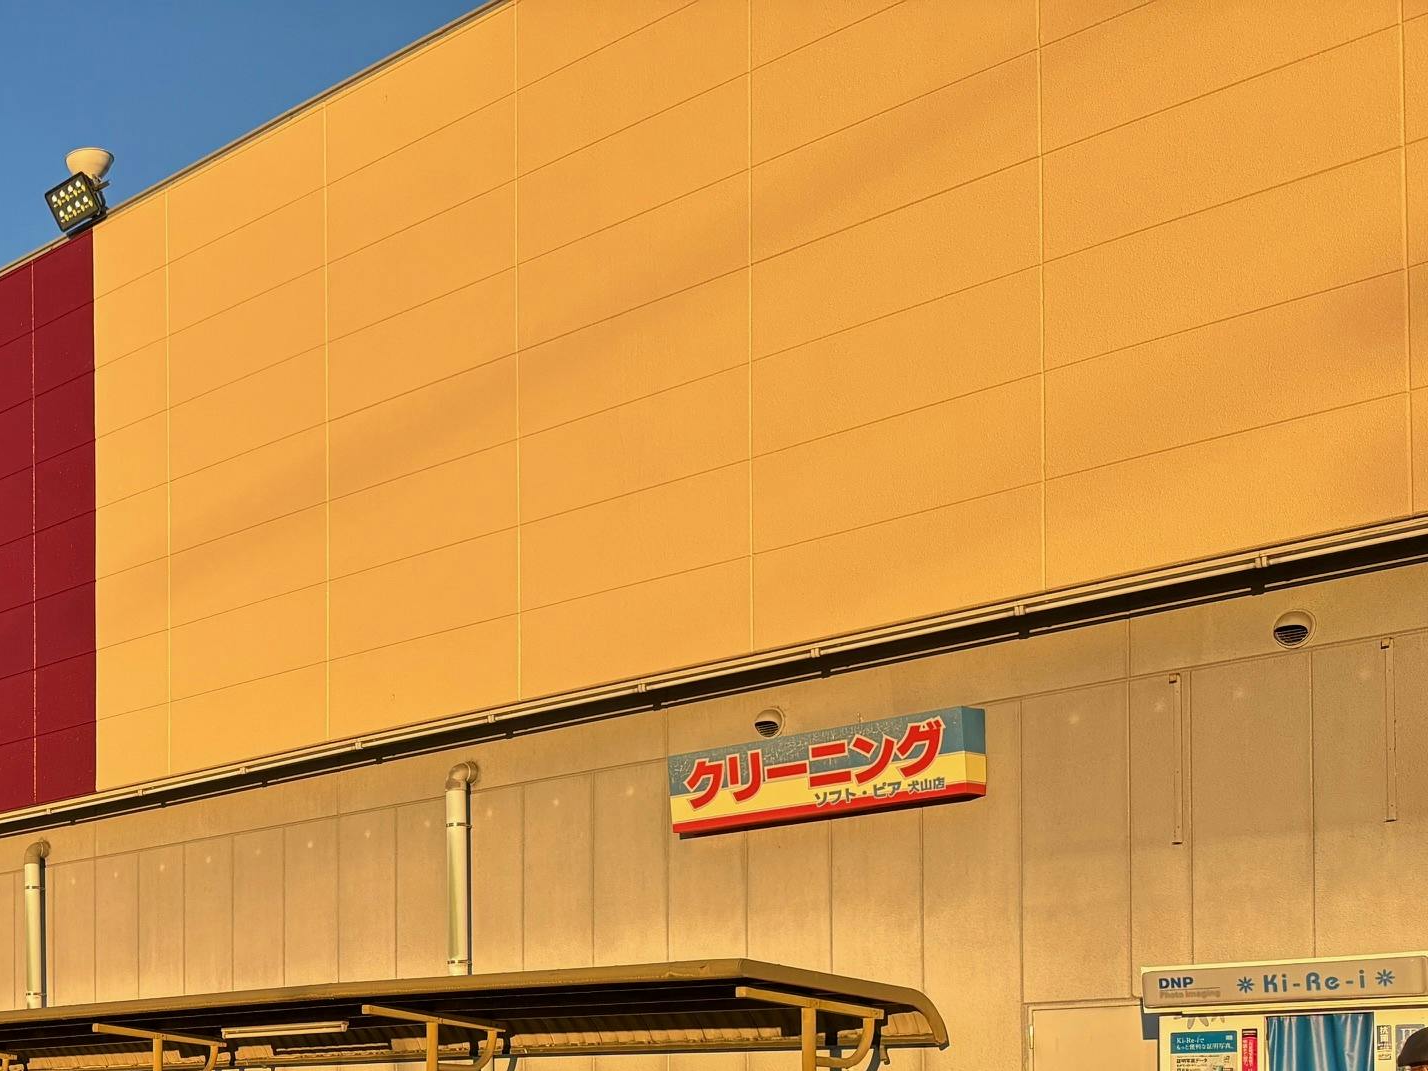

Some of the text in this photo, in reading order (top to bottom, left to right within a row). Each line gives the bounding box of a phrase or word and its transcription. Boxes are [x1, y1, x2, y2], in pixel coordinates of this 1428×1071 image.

[685, 717, 945, 810] クリーニング
[815, 777, 945, 806] ソフト・ピア 犬山店
[1158, 976, 1194, 990] DNP
[1263, 969, 1366, 993] Ki-Re-i
[1159, 989, 1221, 999] Photo Imaging
